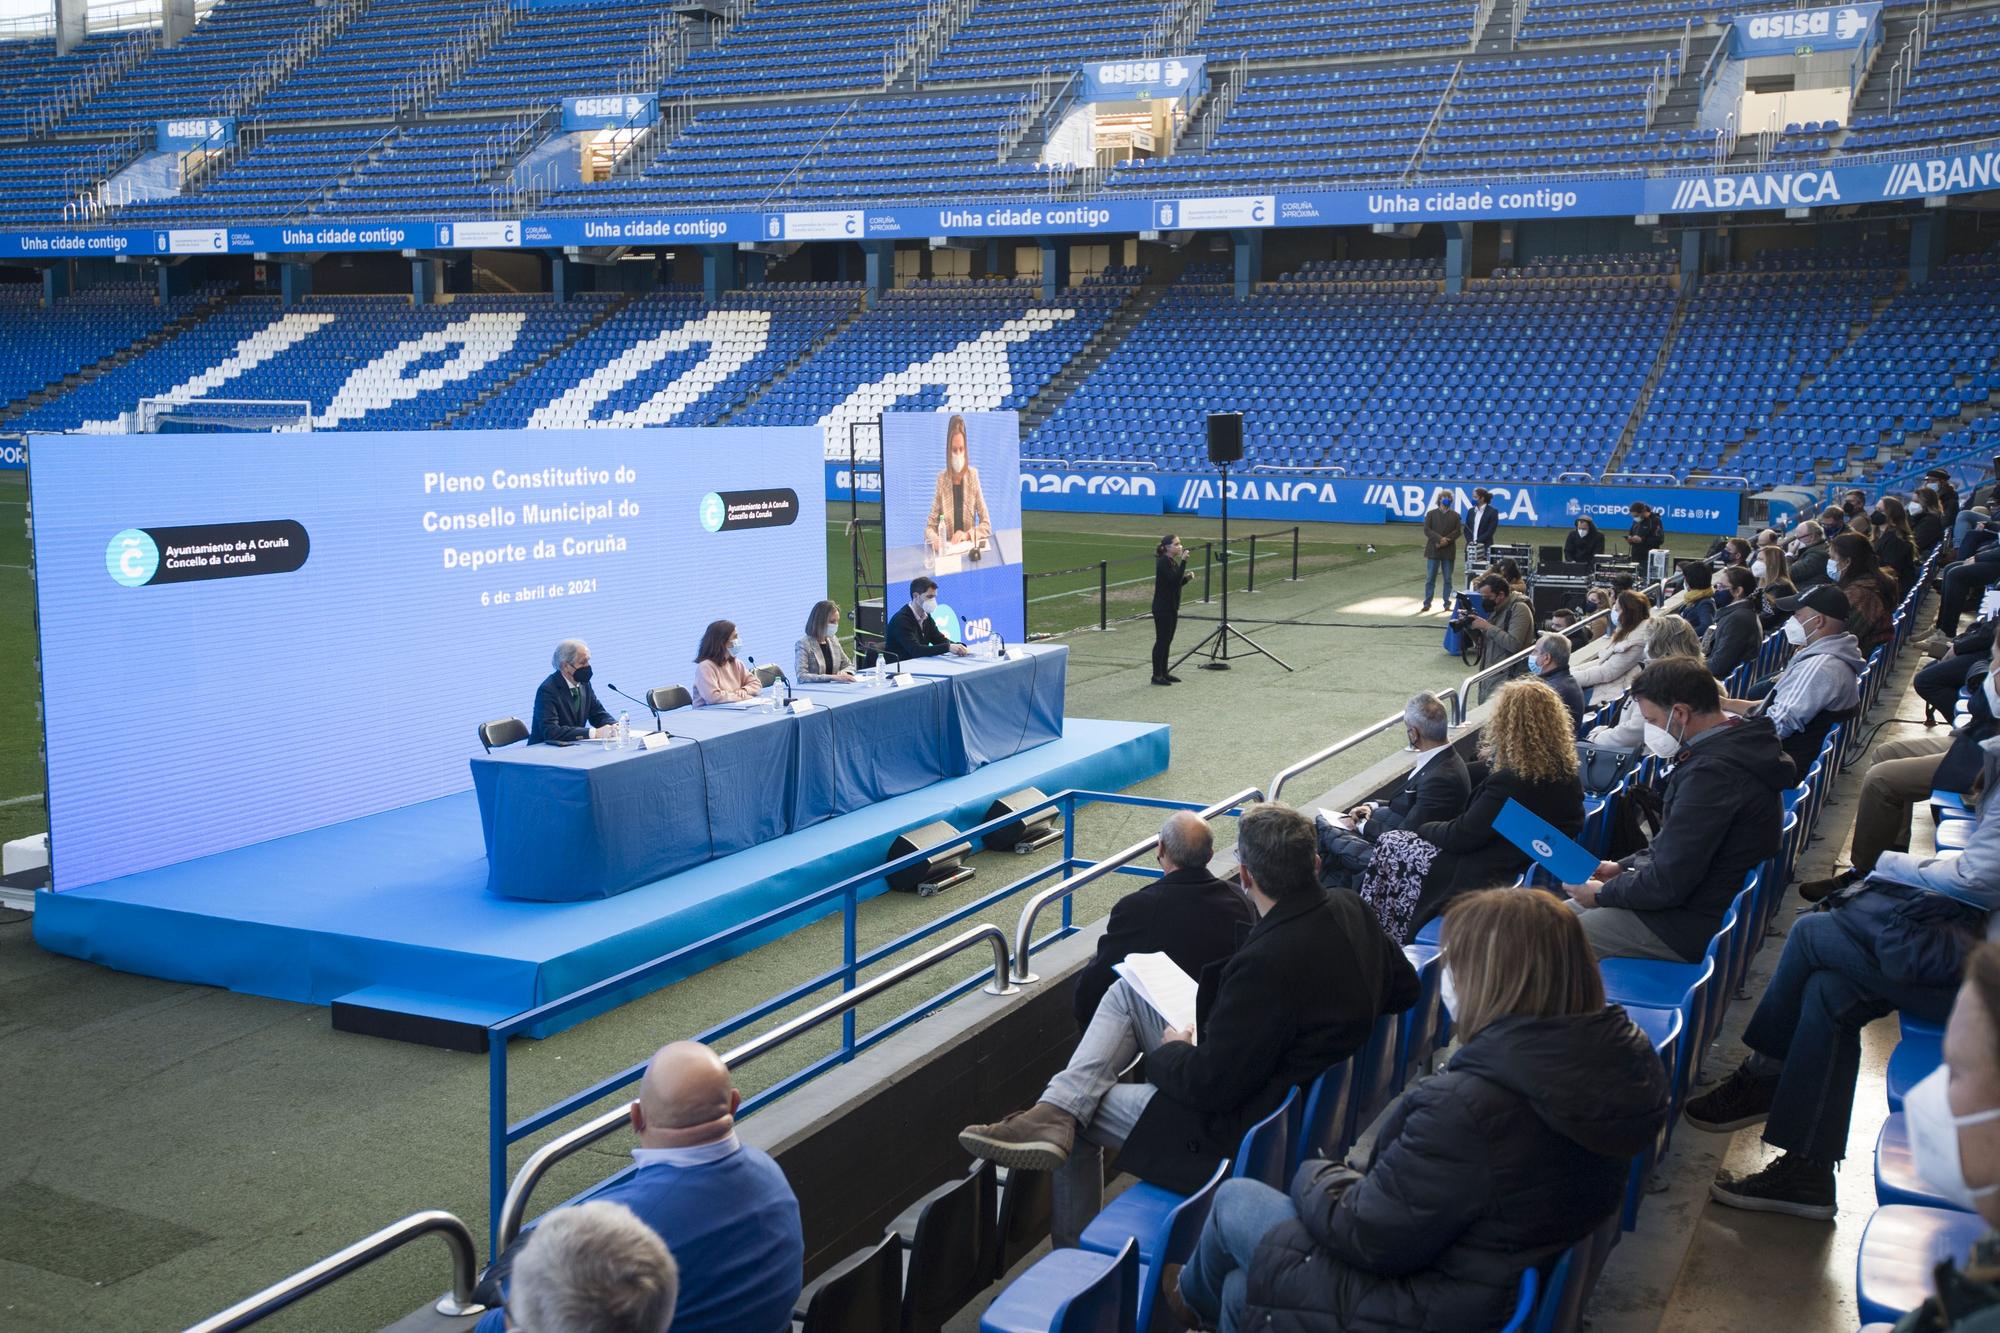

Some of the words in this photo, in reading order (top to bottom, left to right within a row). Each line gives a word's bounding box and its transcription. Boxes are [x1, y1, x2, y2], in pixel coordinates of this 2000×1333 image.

[1749, 12, 1829, 39] asisa
[1099, 62, 1160, 84] asisa
[1368, 194, 1420, 213] Unha
[1425, 191, 1493, 211] cidade
[1499, 189, 1577, 212] contigo
[940, 210, 982, 227] Unha
[987, 208, 1042, 226] cidade
[1046, 207, 1110, 227] contigo
[282, 229, 314, 244] Unha
[317, 228, 356, 243] cidade
[359, 227, 405, 245] contigo
[584, 221, 621, 238] Unha
[624, 220, 670, 237] cidade
[674, 219, 727, 239] contigo
[21, 237, 48, 250] Unha
[50, 235, 85, 249] cidade
[87, 234, 128, 251] contigo
[424, 471, 486, 494] Pleno
[492, 466, 609, 490] Constitutivo
[614, 464, 637, 484] do
[423, 506, 516, 532] Consello
[523, 499, 613, 525] Municipal
[618, 498, 640, 517] do
[166, 541, 234, 558] Ayuntamiento
[236, 541, 247, 551] de
[249, 540, 257, 550] A
[258, 537, 289, 549] Coruña
[443, 543, 526, 572] Deporte
[533, 539, 556, 559] da
[562, 533, 627, 557] Coruña
[166, 555, 208, 569] Concello
[209, 554, 221, 566] da
[224, 552, 256, 564] Coruña
[480, 591, 490, 607] 6
[494, 591, 510, 604] de
[515, 584, 545, 602] abril
[549, 583, 564, 597] de
[568, 578, 597, 596] 2021
[965, 618, 992, 641] CMD
